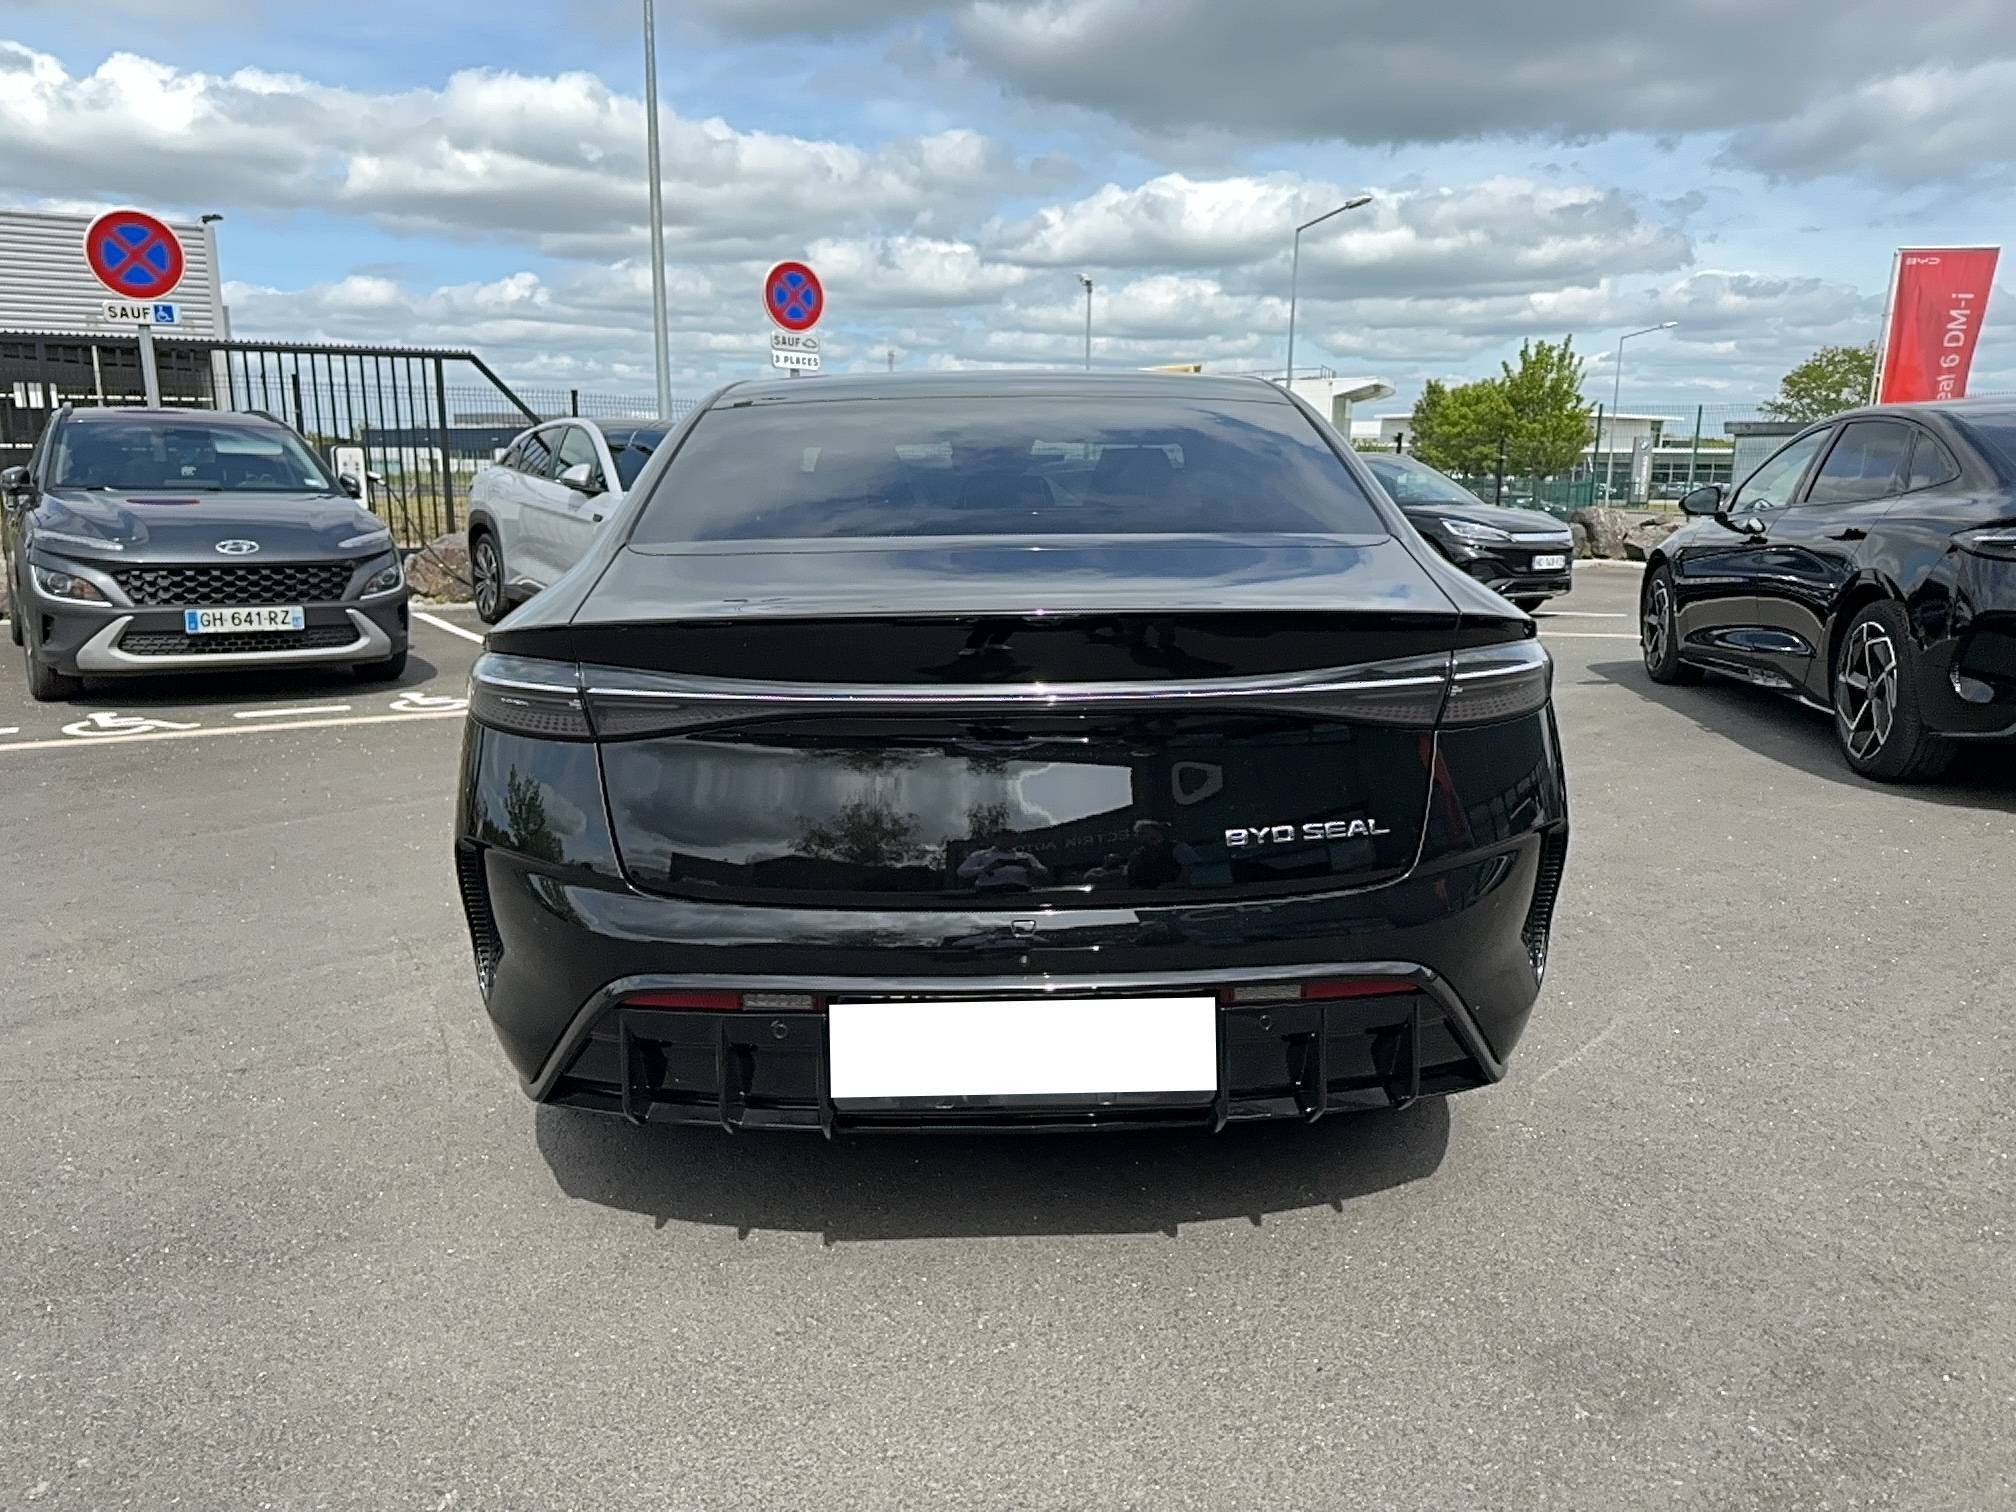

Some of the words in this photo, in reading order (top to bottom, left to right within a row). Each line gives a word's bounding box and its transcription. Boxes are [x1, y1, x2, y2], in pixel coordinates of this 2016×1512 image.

[1905, 257, 1941, 265] BYD
[107, 305, 150, 320] SAUF
[1943, 293, 1975, 347] DM-i
[773, 335, 801, 347] SAUF
[775, 354, 780, 364] 3
[783, 355, 819, 367] PLACES
[1940, 354, 1960, 368] 6
[1936, 373, 1956, 400] eal
[1225, 825, 1295, 847] BYD
[1302, 819, 1391, 841] SEAL
